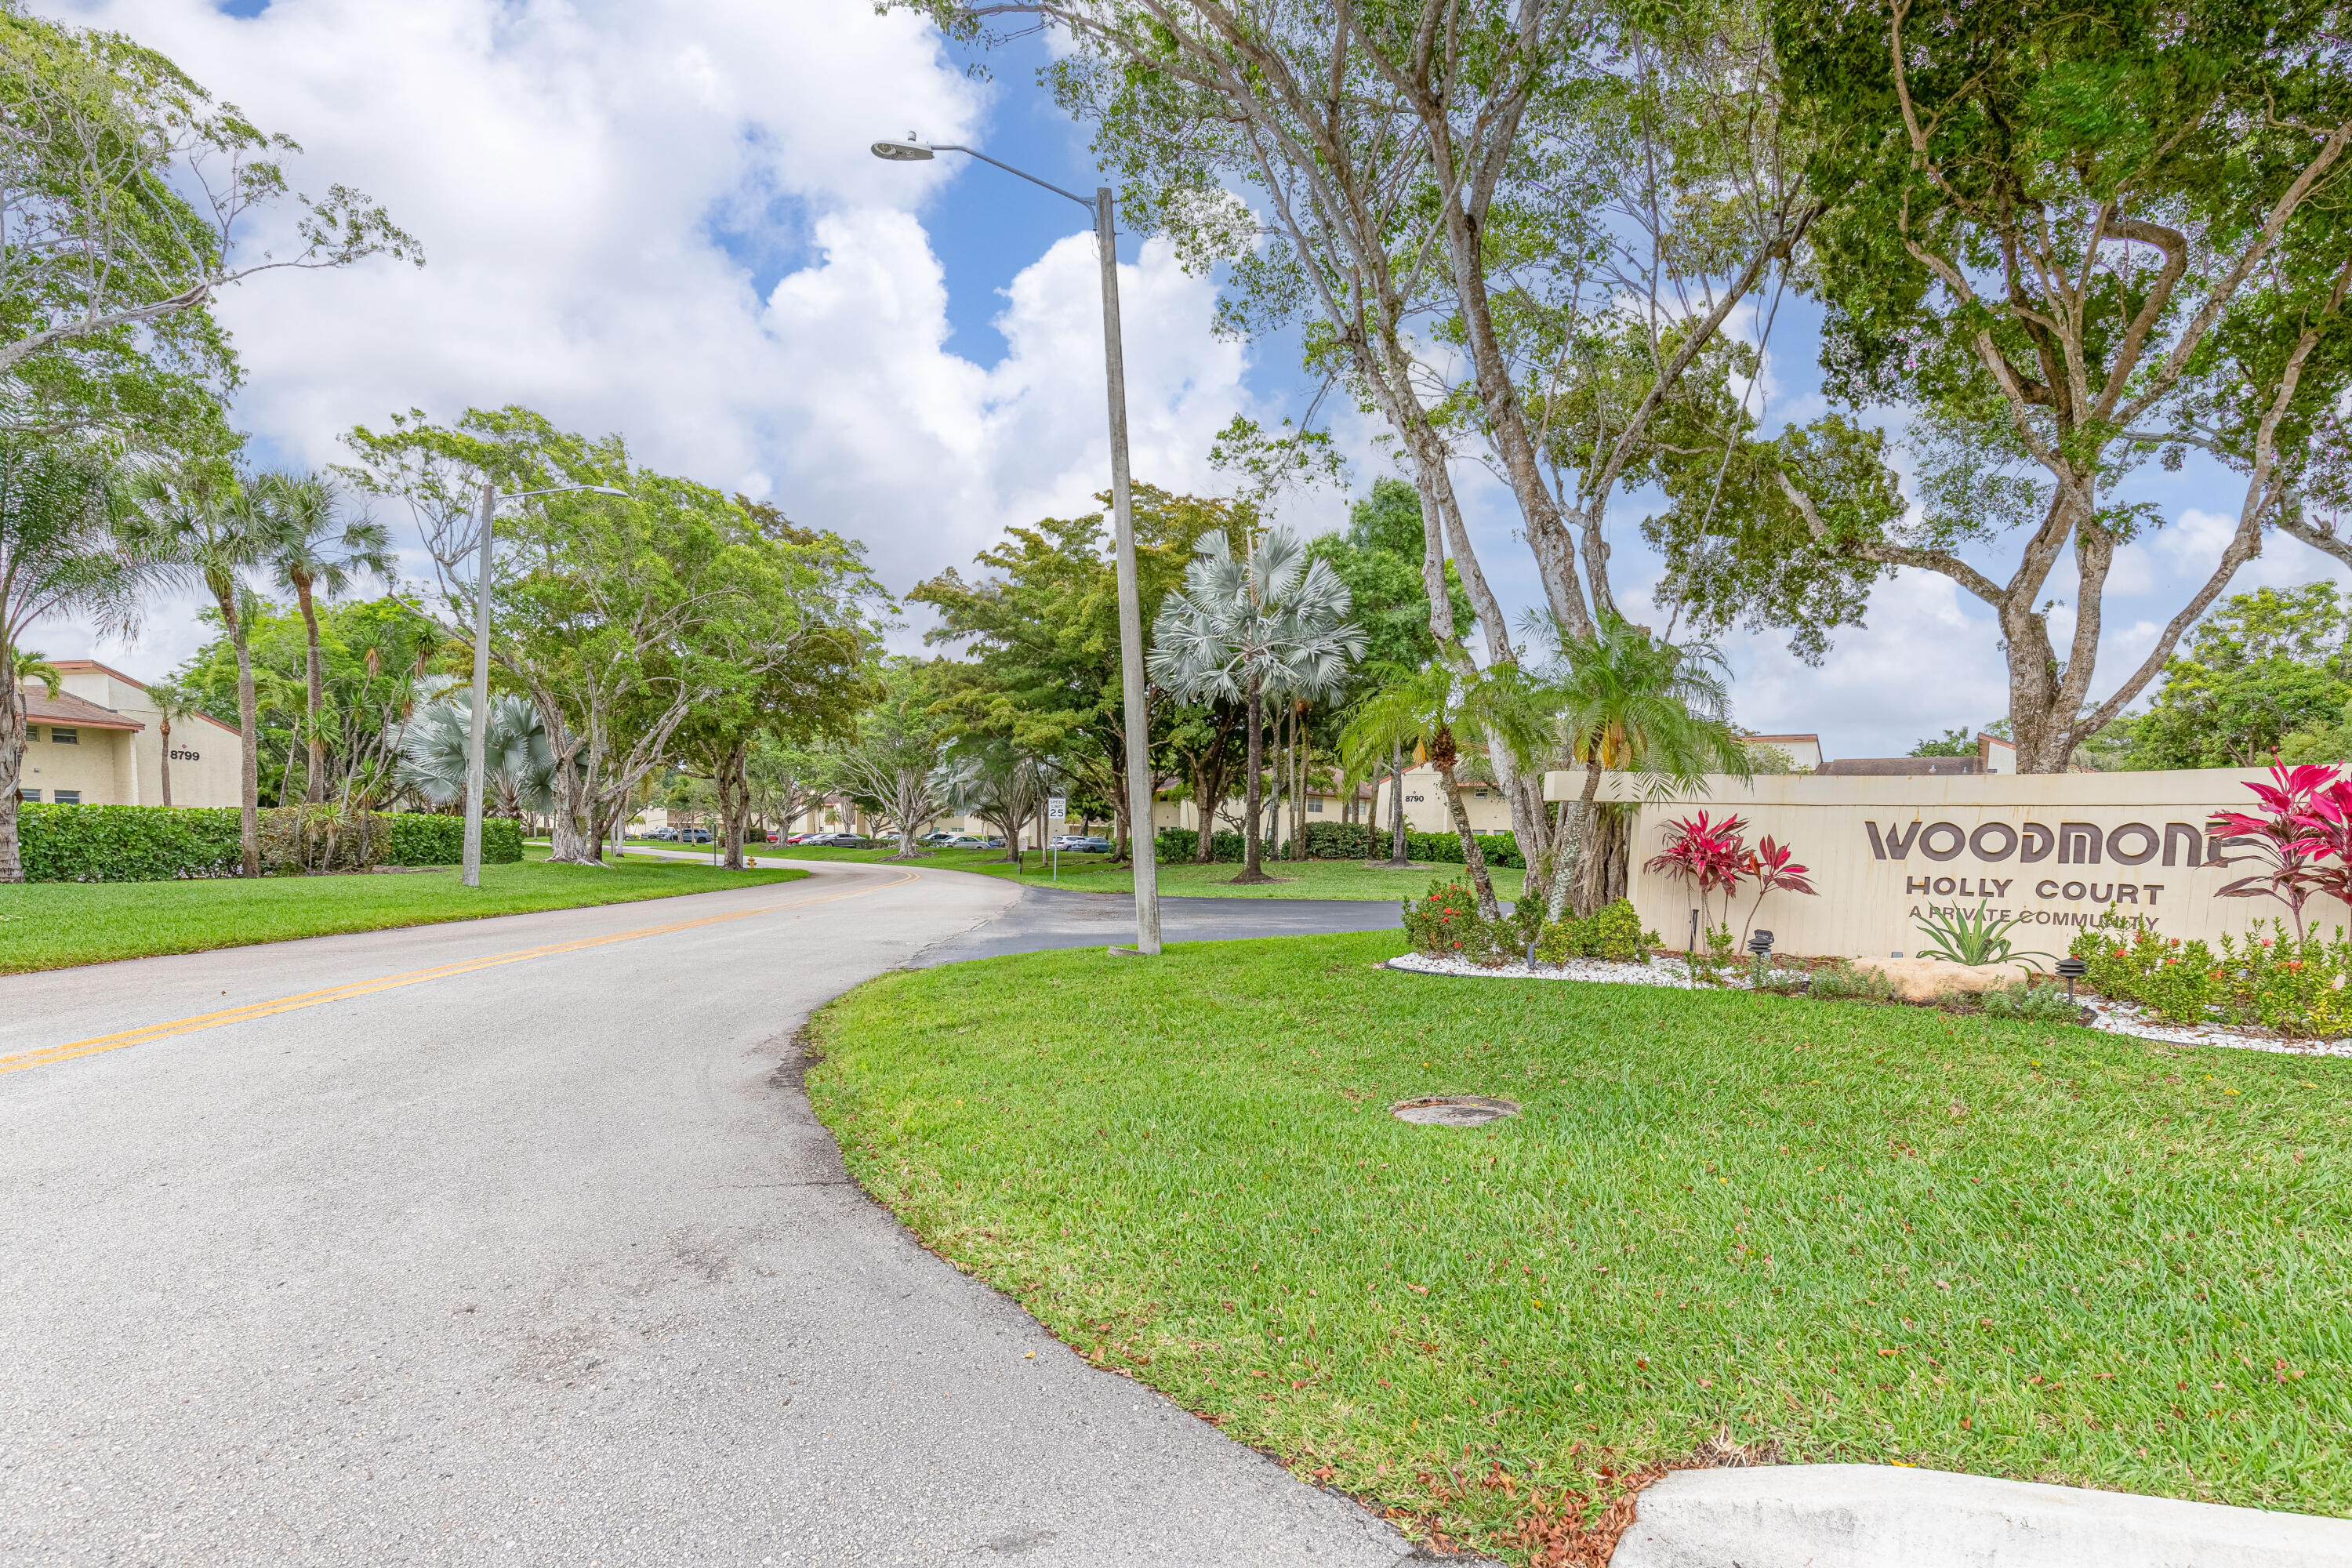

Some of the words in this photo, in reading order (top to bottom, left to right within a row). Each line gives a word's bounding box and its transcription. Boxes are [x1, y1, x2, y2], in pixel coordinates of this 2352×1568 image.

[170, 750, 200, 760] 8799
[1906, 876, 2013, 898] HOLLY
[2035, 879, 2165, 906] COURT
[1908, 905, 1922, 918] A
[1929, 906, 2012, 923] PRVATE
[2019, 909, 2160, 931] COMMUTY
